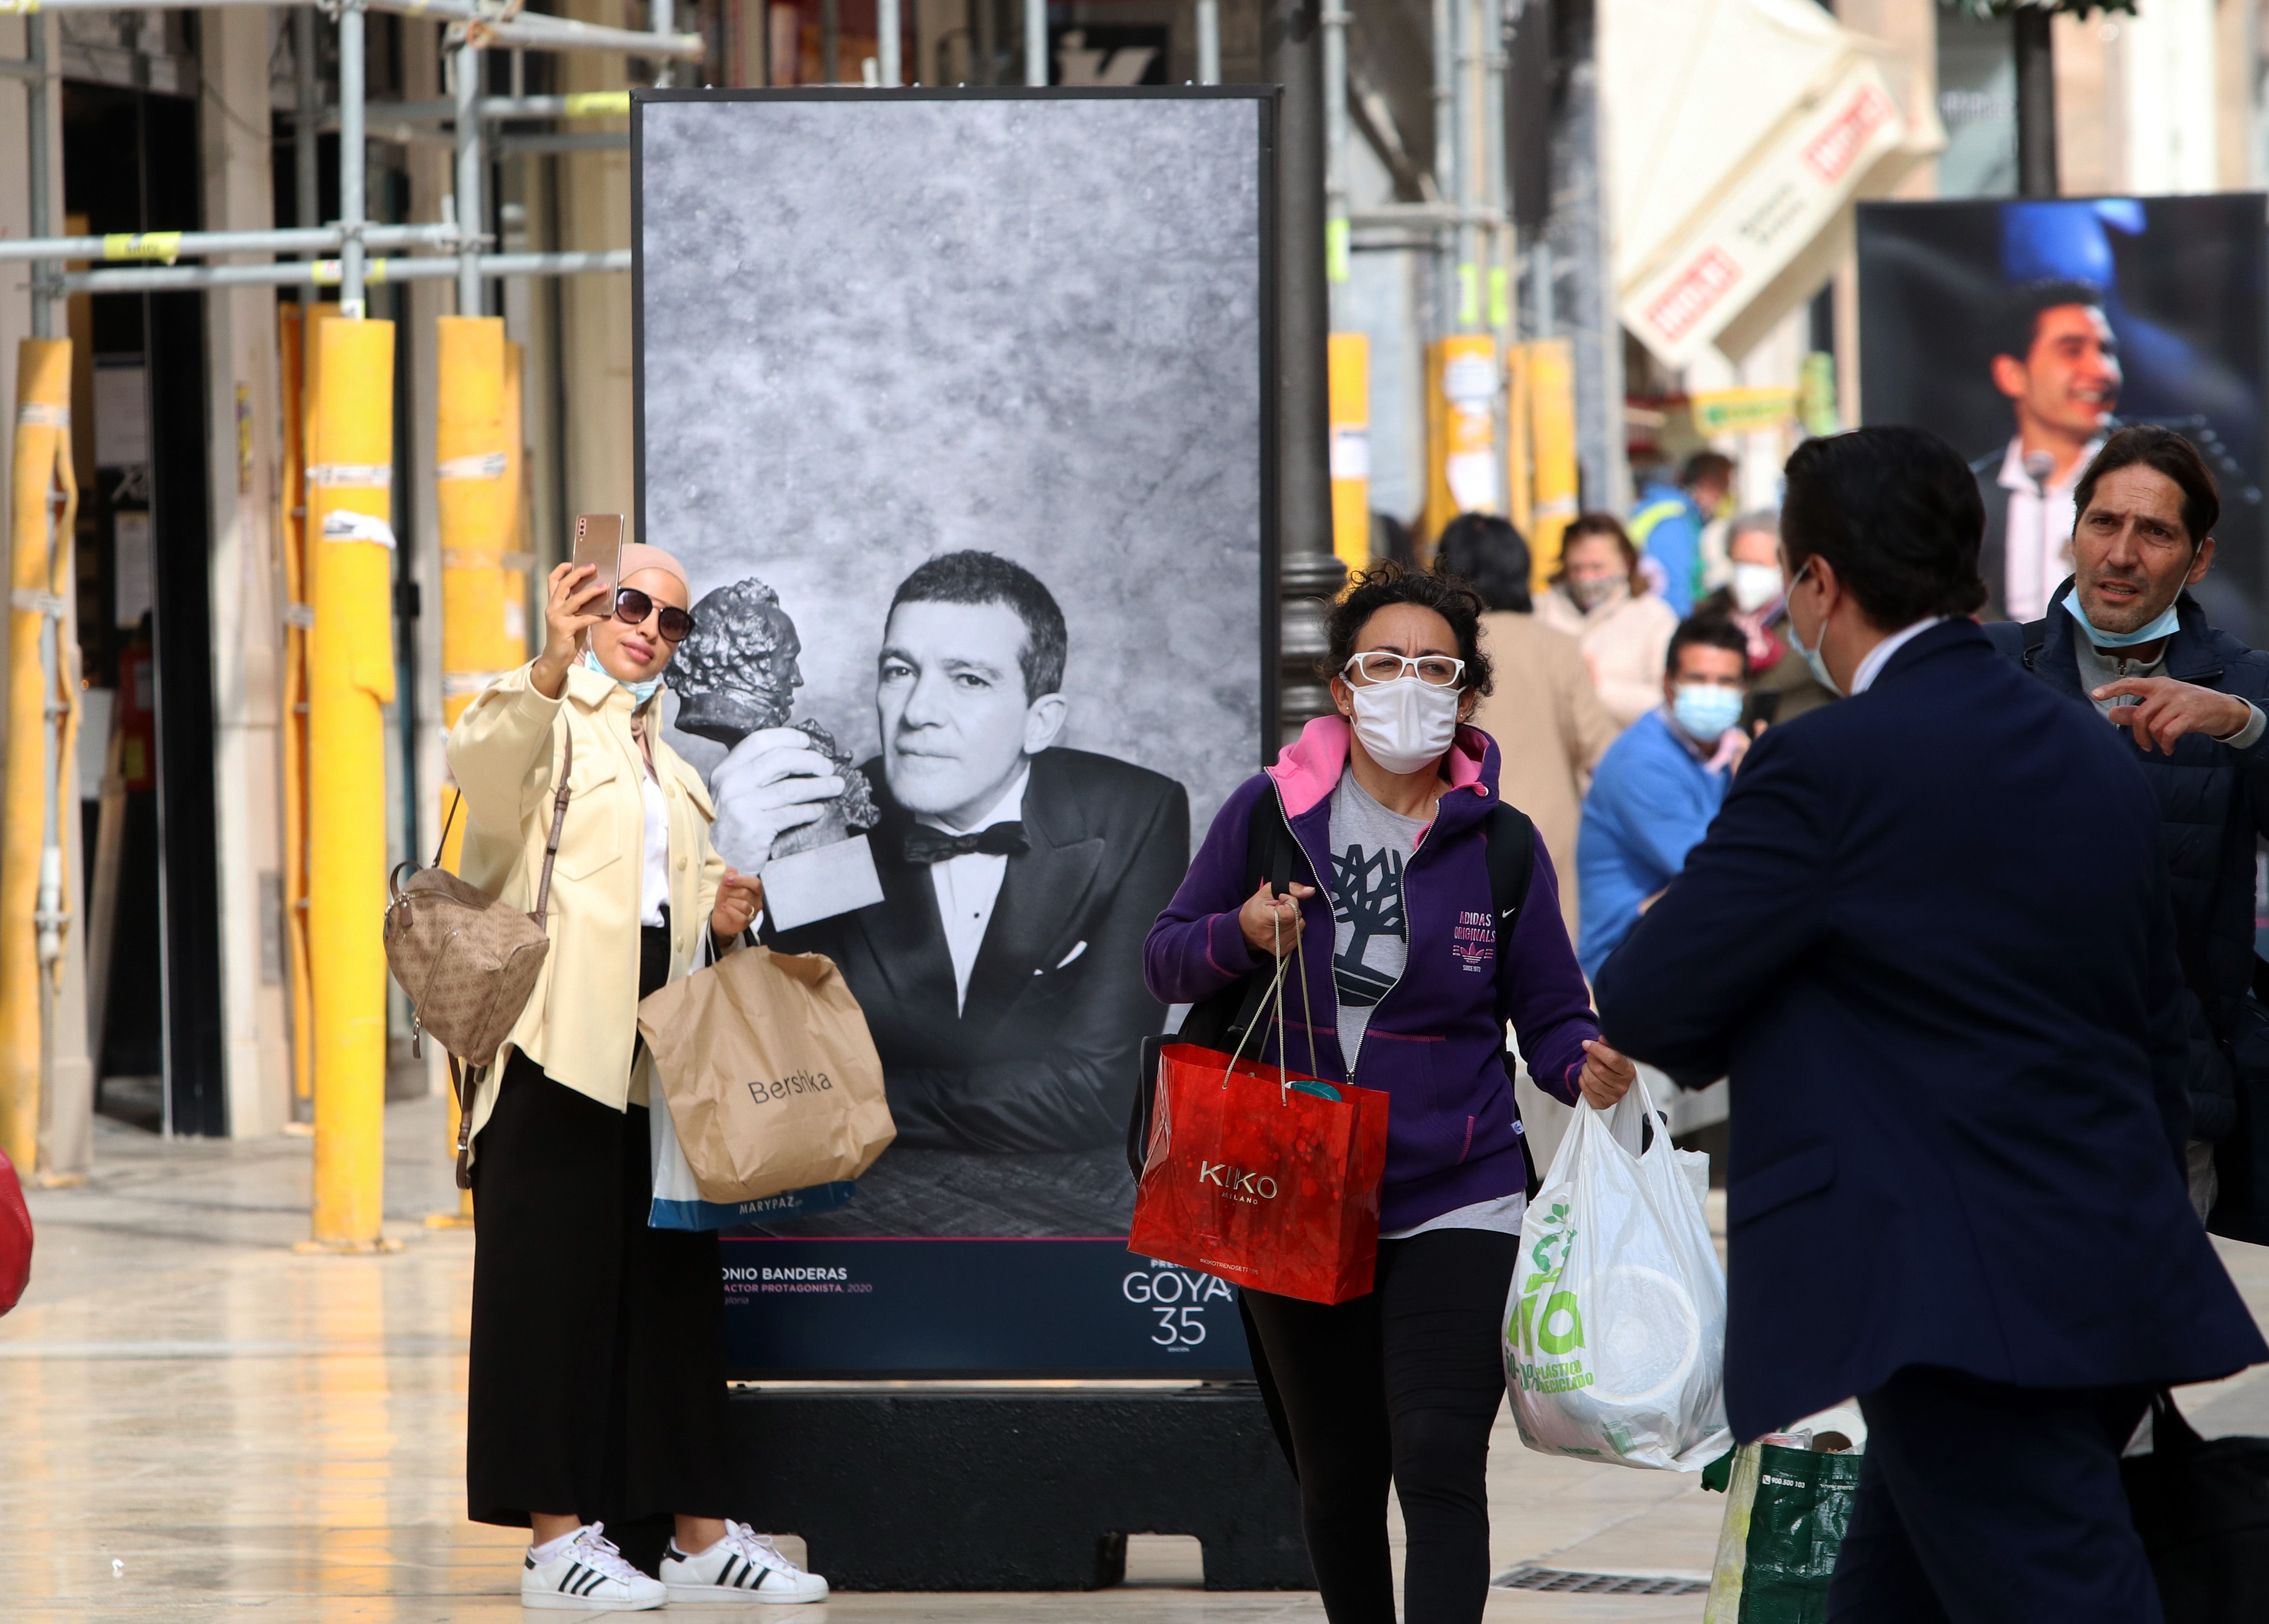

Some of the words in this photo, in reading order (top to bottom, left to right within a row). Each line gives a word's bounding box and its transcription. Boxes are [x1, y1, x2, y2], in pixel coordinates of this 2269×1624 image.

[1459, 911, 1492, 926] ADIDAS
[1454, 926, 1496, 942] ORIGINALS
[748, 1069, 833, 1104] Bershka
[1199, 1160, 1278, 1199] KIKO
[739, 1196, 794, 1215] MARYPAZ
[1221, 1191, 1258, 1205] MILANO
[1151, 1259, 1190, 1268] PRE
[1199, 1258, 1259, 1275] #KIKOTRENDSETTERS
[762, 1267, 847, 1280] BANDERAS
[724, 1283, 759, 1293] ACTOR
[847, 1283, 873, 1293] 2020
[1123, 1271, 1233, 1303] GOYA
[1151, 1307, 1206, 1345] 35
[1536, 1360, 1583, 1379] PLÁSTICO
[1539, 1372, 1595, 1394] RECICLADO
[1795, 1481, 1805, 1489] 103
